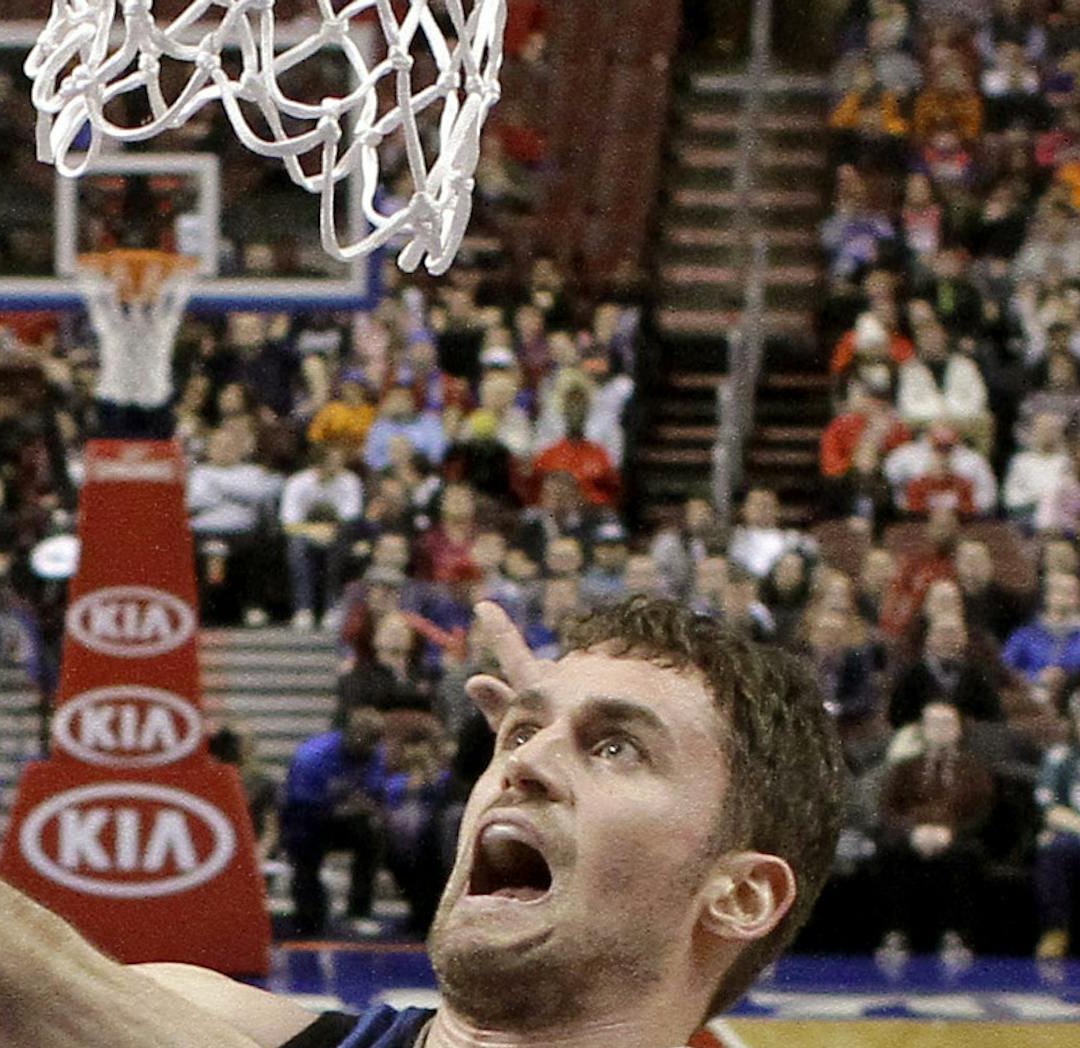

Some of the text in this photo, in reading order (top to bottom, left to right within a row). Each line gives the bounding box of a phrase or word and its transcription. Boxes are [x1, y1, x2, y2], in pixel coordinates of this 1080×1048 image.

[90, 603, 170, 638] KIA
[79, 704, 179, 750] KIA
[58, 808, 198, 873] KIA
